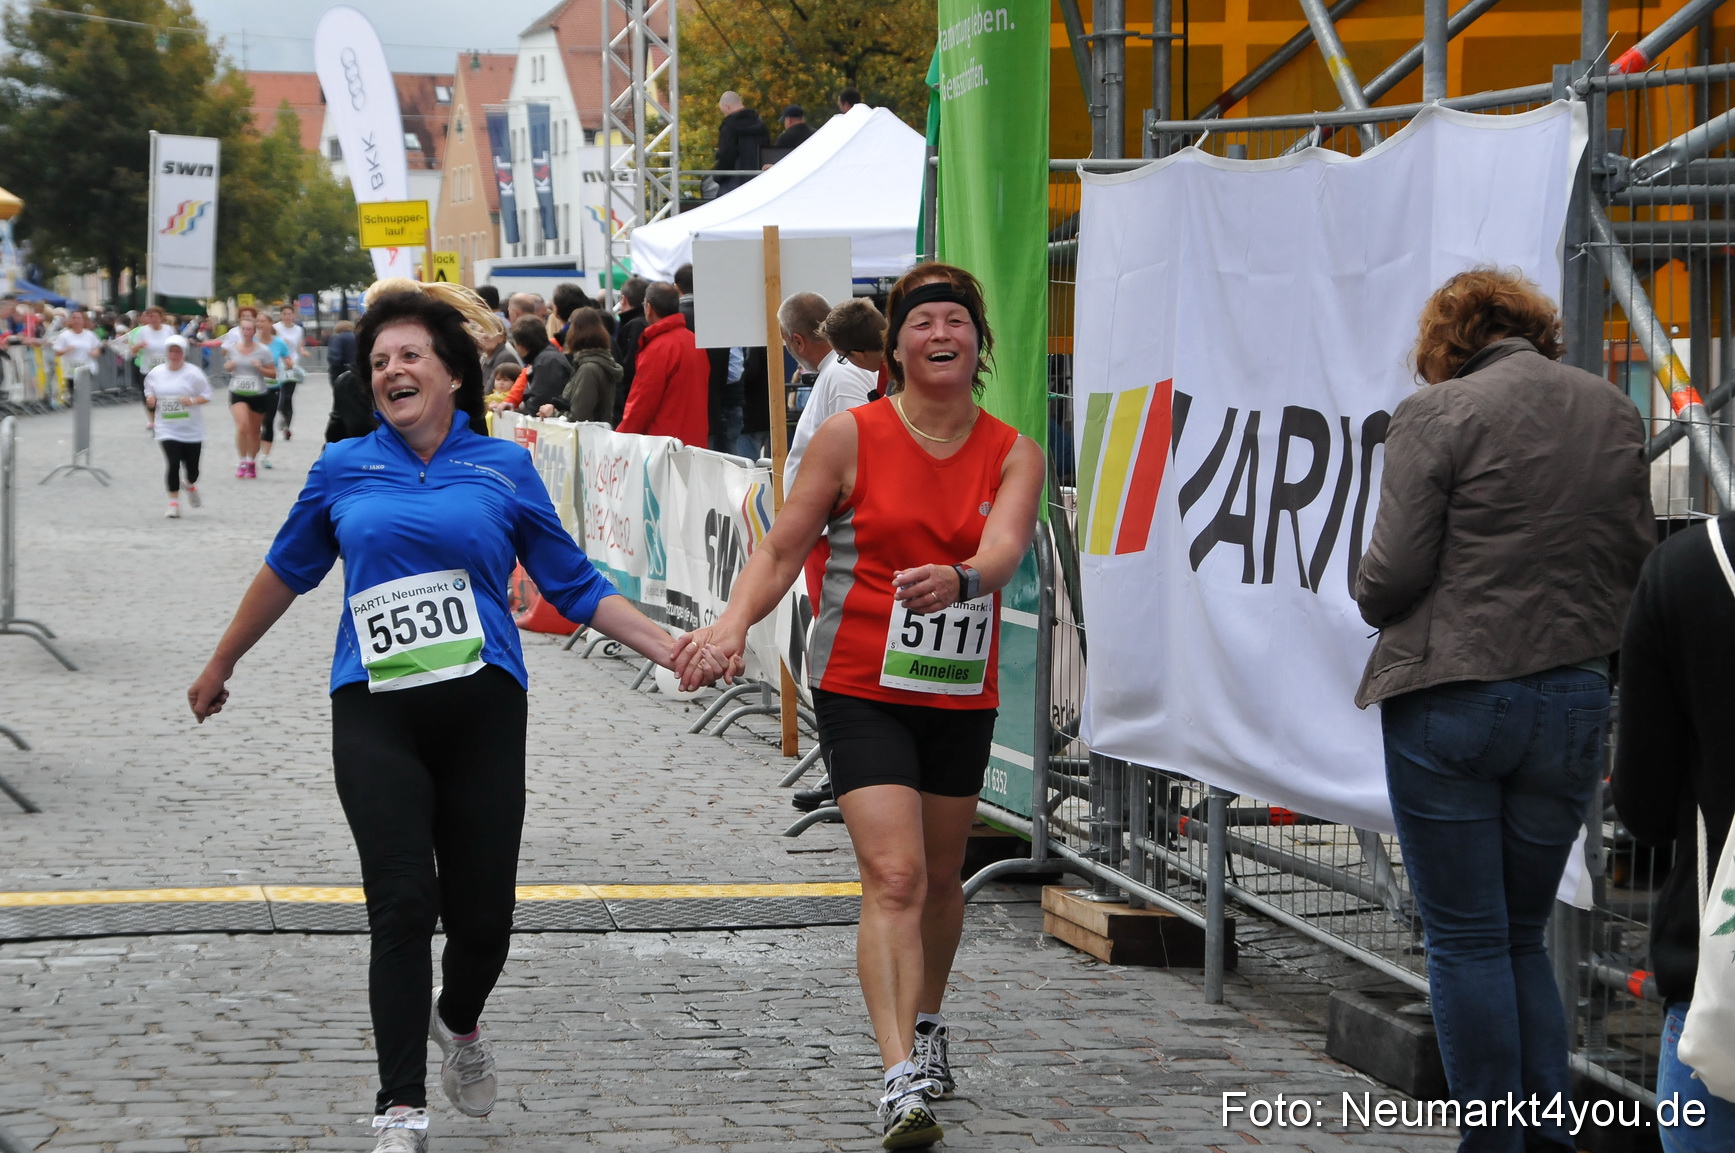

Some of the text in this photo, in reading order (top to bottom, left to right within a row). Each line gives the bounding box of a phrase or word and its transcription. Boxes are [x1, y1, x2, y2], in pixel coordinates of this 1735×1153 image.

[361, 130, 384, 191] BKK
[363, 213, 425, 225] Schnupper-
[385, 226, 405, 236] lauf
[433, 254, 455, 264] lock
[353, 582, 449, 616] PARTL Neumarkt
[948, 601, 988, 612] umarkt
[367, 597, 468, 654] 5530
[901, 608, 988, 655] 5111
[909, 660, 970, 681] Annelies
[1052, 699, 1075, 727] arkt
[991, 767, 1008, 795] 6352
